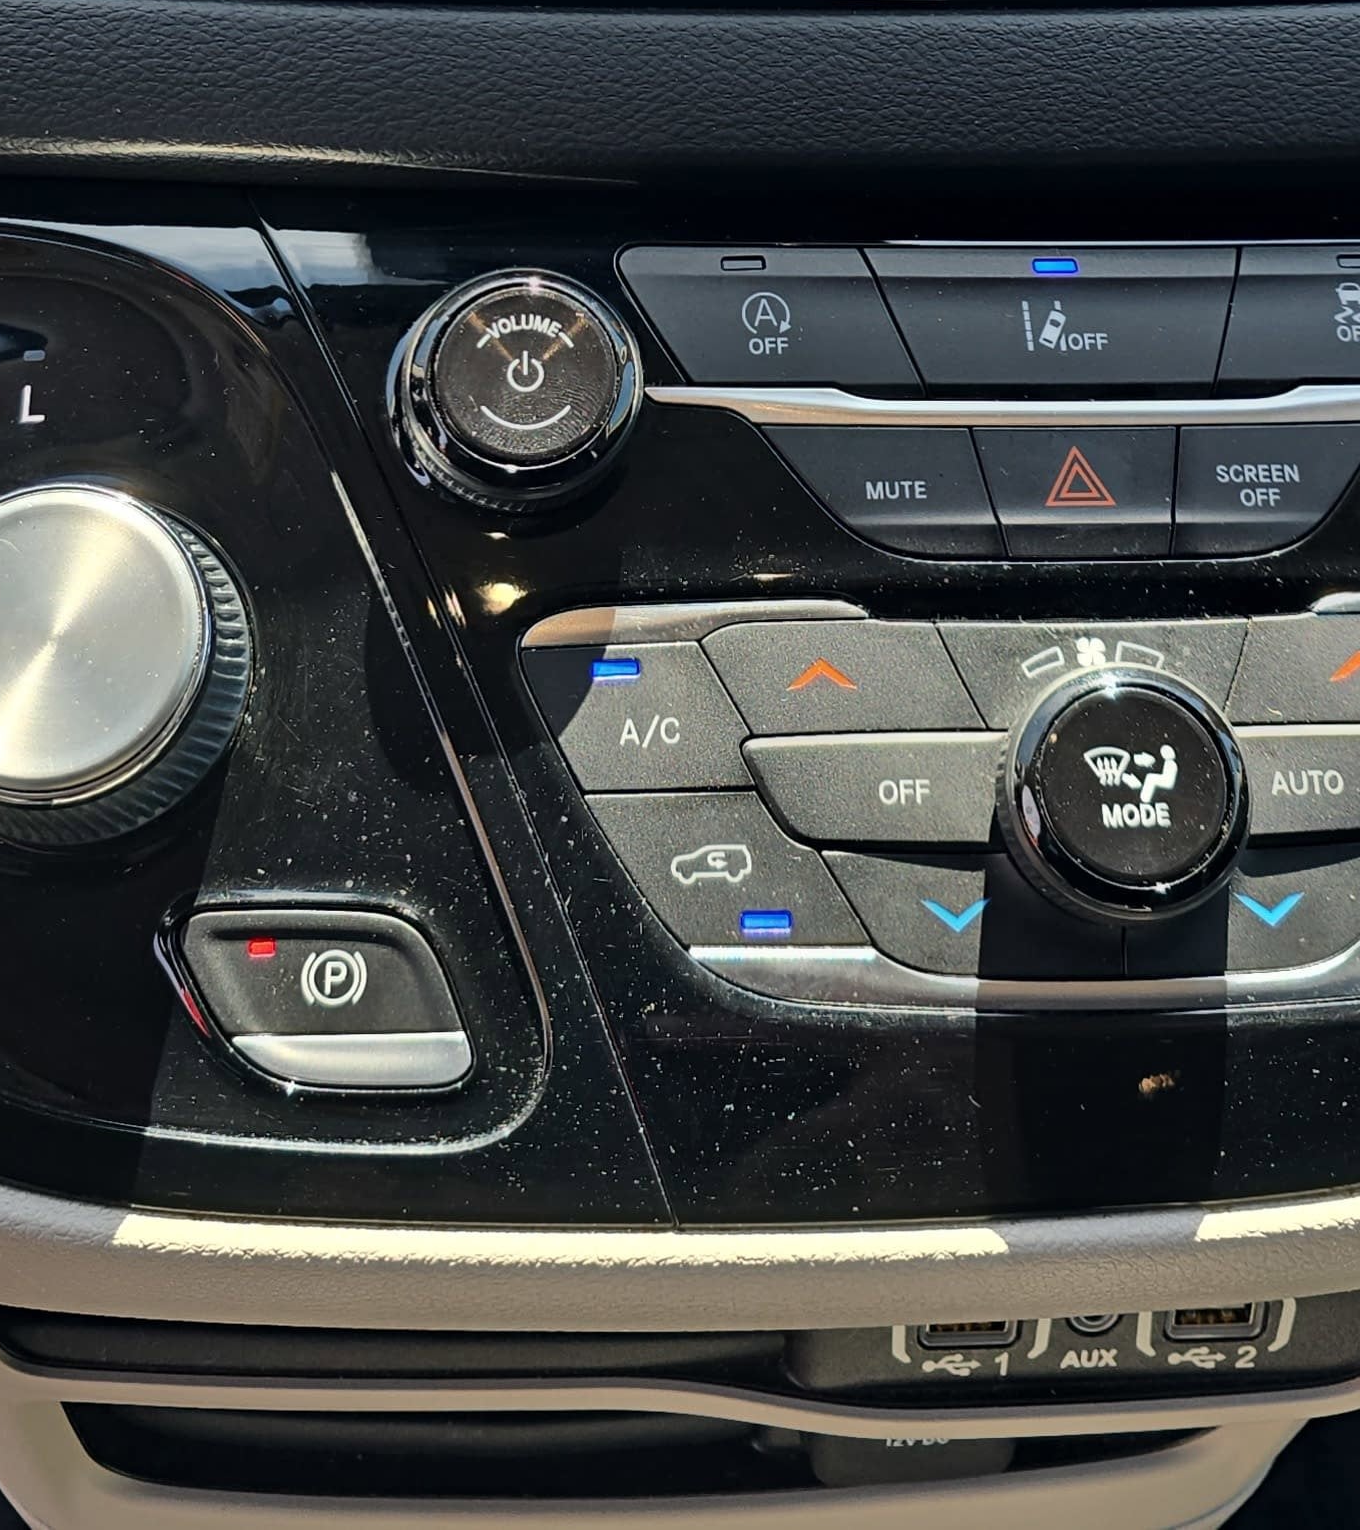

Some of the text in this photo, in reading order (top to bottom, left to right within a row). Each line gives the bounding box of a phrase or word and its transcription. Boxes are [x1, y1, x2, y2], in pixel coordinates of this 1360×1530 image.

[487, 313, 565, 341] VOLUME
[748, 337, 789, 355] OFF
[1068, 332, 1108, 351] OFF
[1215, 464, 1300, 483] SCREEN
[865, 480, 928, 500] MUTE
[1239, 487, 1281, 507] OFF
[619, 714, 681, 749] A/C
[878, 778, 930, 806] OFF
[1271, 769, 1344, 796] AUTO
[1101, 799, 1172, 829] MODE
[1059, 1348, 1118, 1369] AUX
[1234, 1345, 1258, 1369] 2
